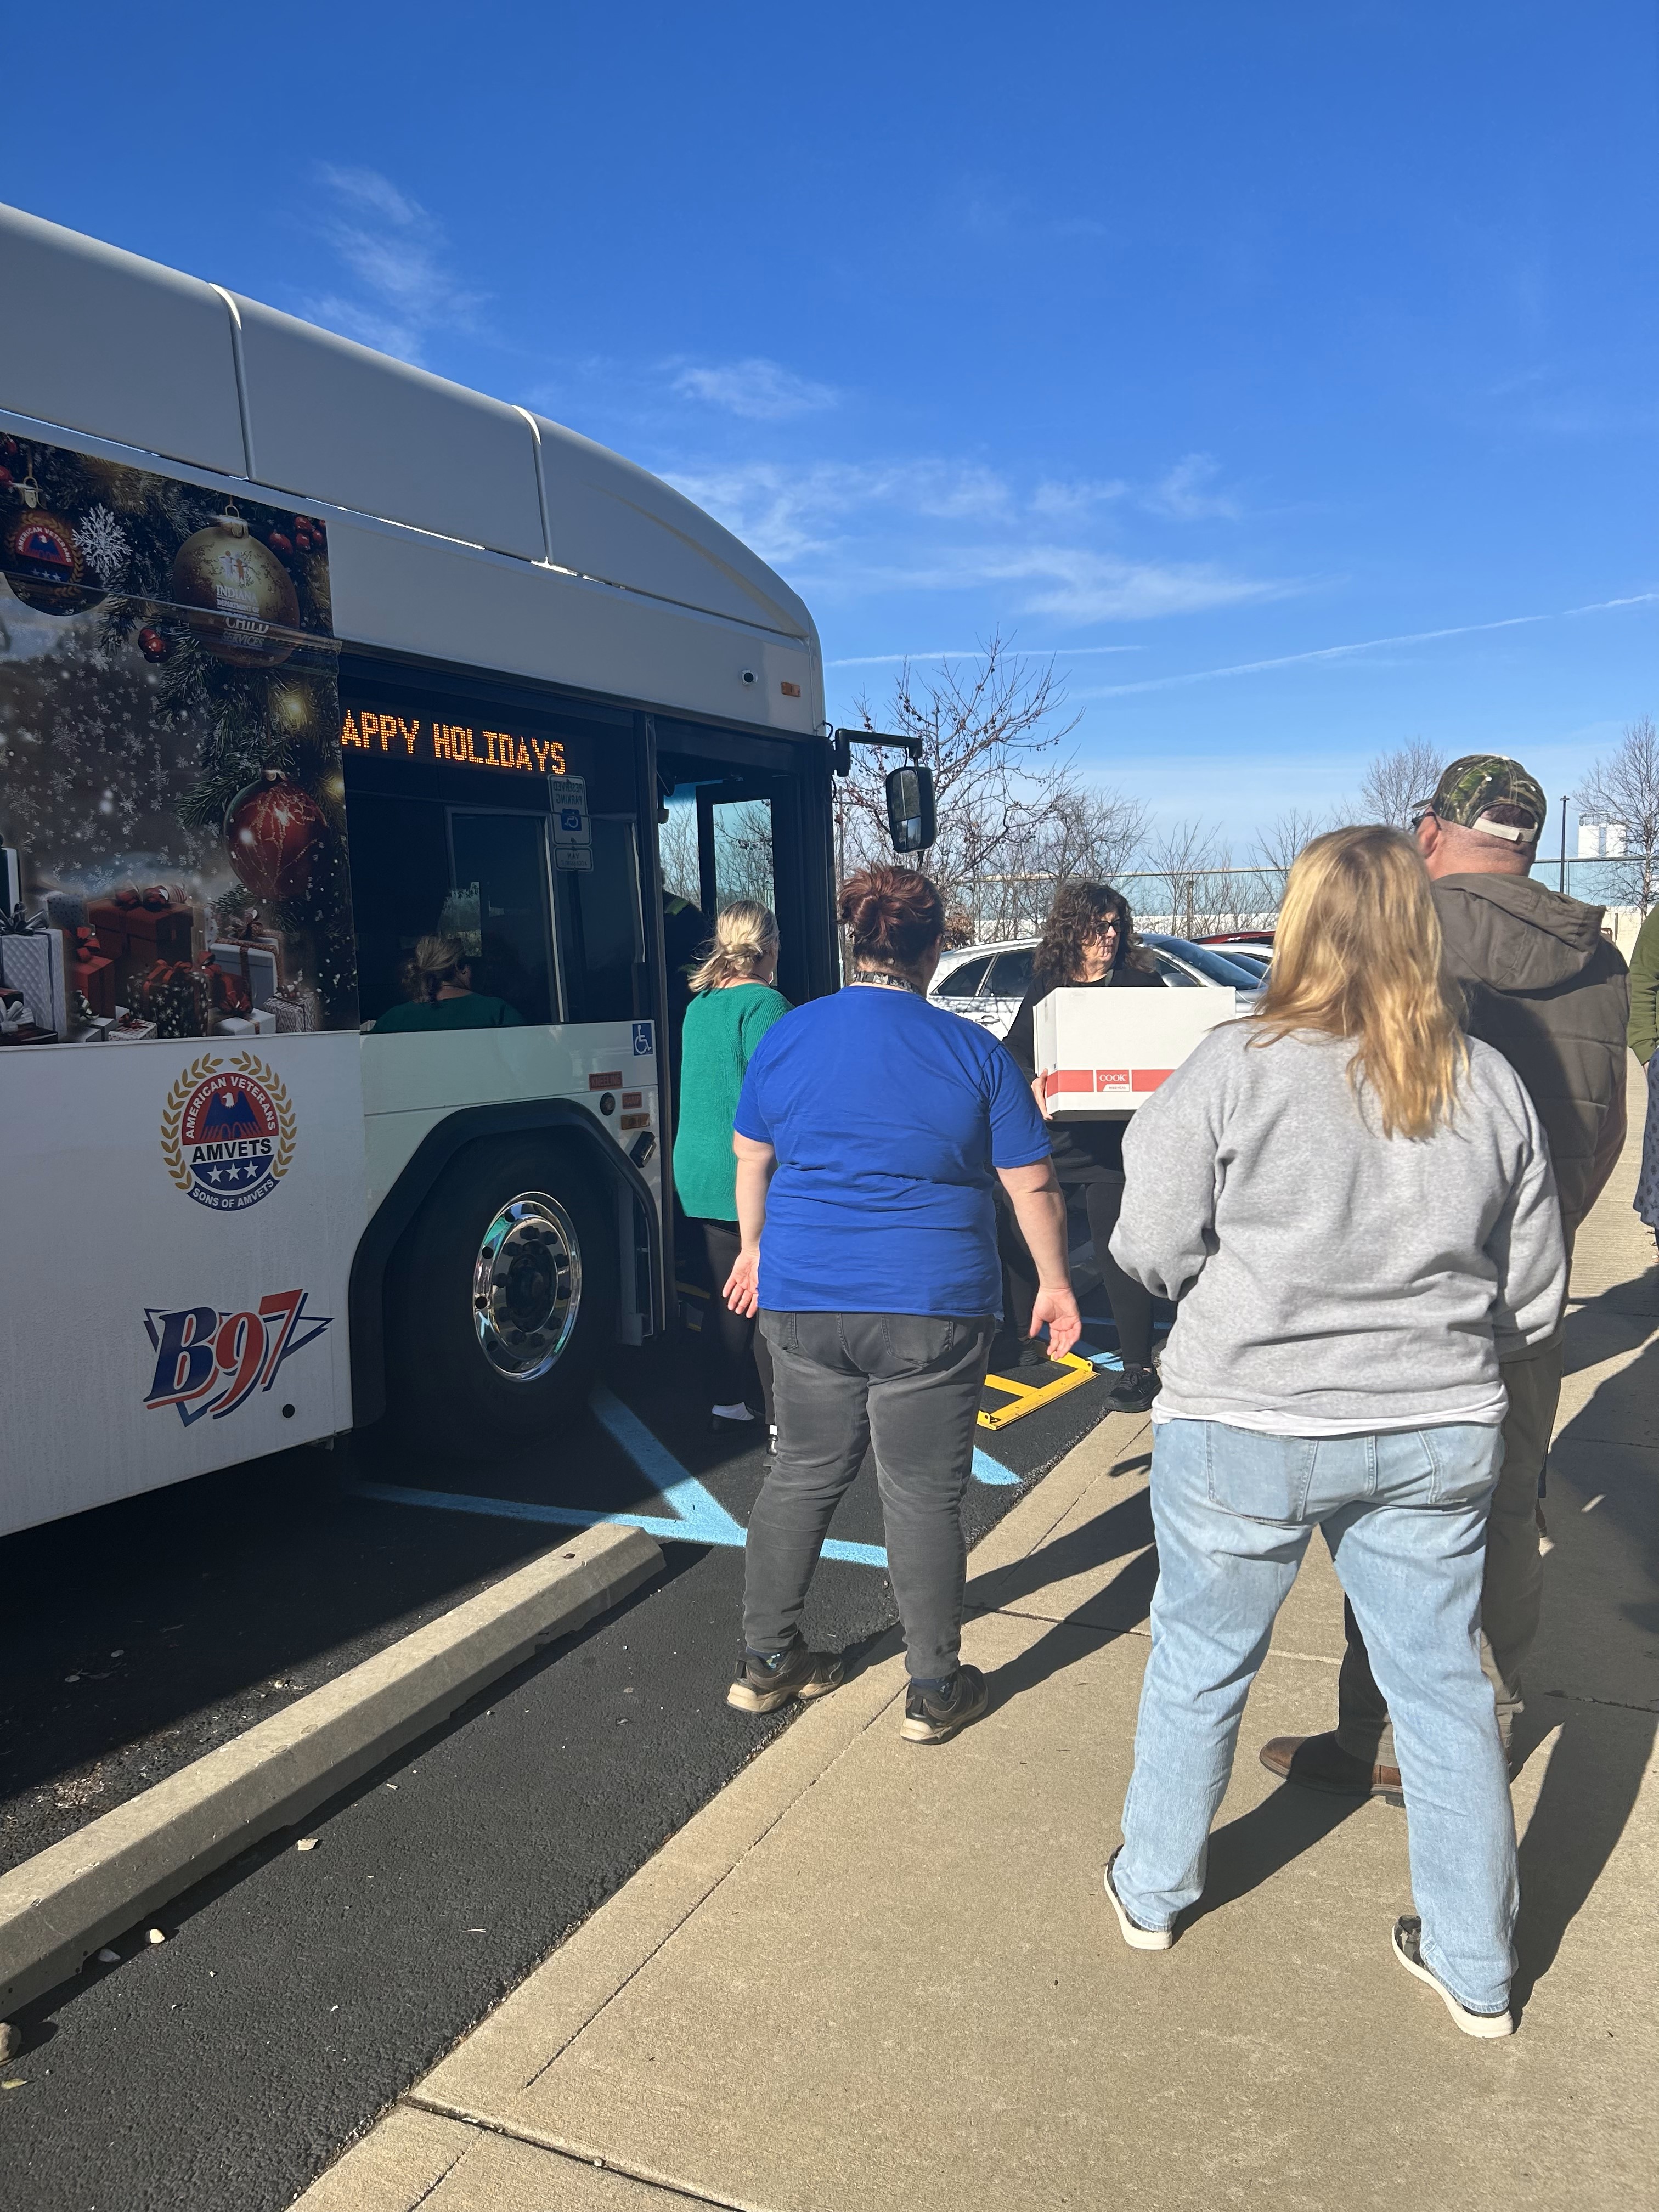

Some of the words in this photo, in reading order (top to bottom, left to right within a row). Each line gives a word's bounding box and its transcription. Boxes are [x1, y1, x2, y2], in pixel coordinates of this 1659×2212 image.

[216, 585, 257, 605] INDIANA
[225, 617, 269, 634] CHILD
[222, 631, 264, 647] SERVICES
[341, 709, 420, 754] APPY
[433, 722, 566, 775] HOLIDAYS
[1099, 1074, 1126, 1082] COOK
[185, 1077, 227, 1139] AMERICAN
[230, 1076, 276, 1130] VETERANS
[623, 1096, 641, 1106] RAMP
[192, 1138, 272, 1163] AMVETS
[192, 1187, 219, 1206] SONS
[222, 1199, 235, 1208] OF
[238, 1178, 274, 1207] AMVETS
[143, 1289, 309, 1419] B97
